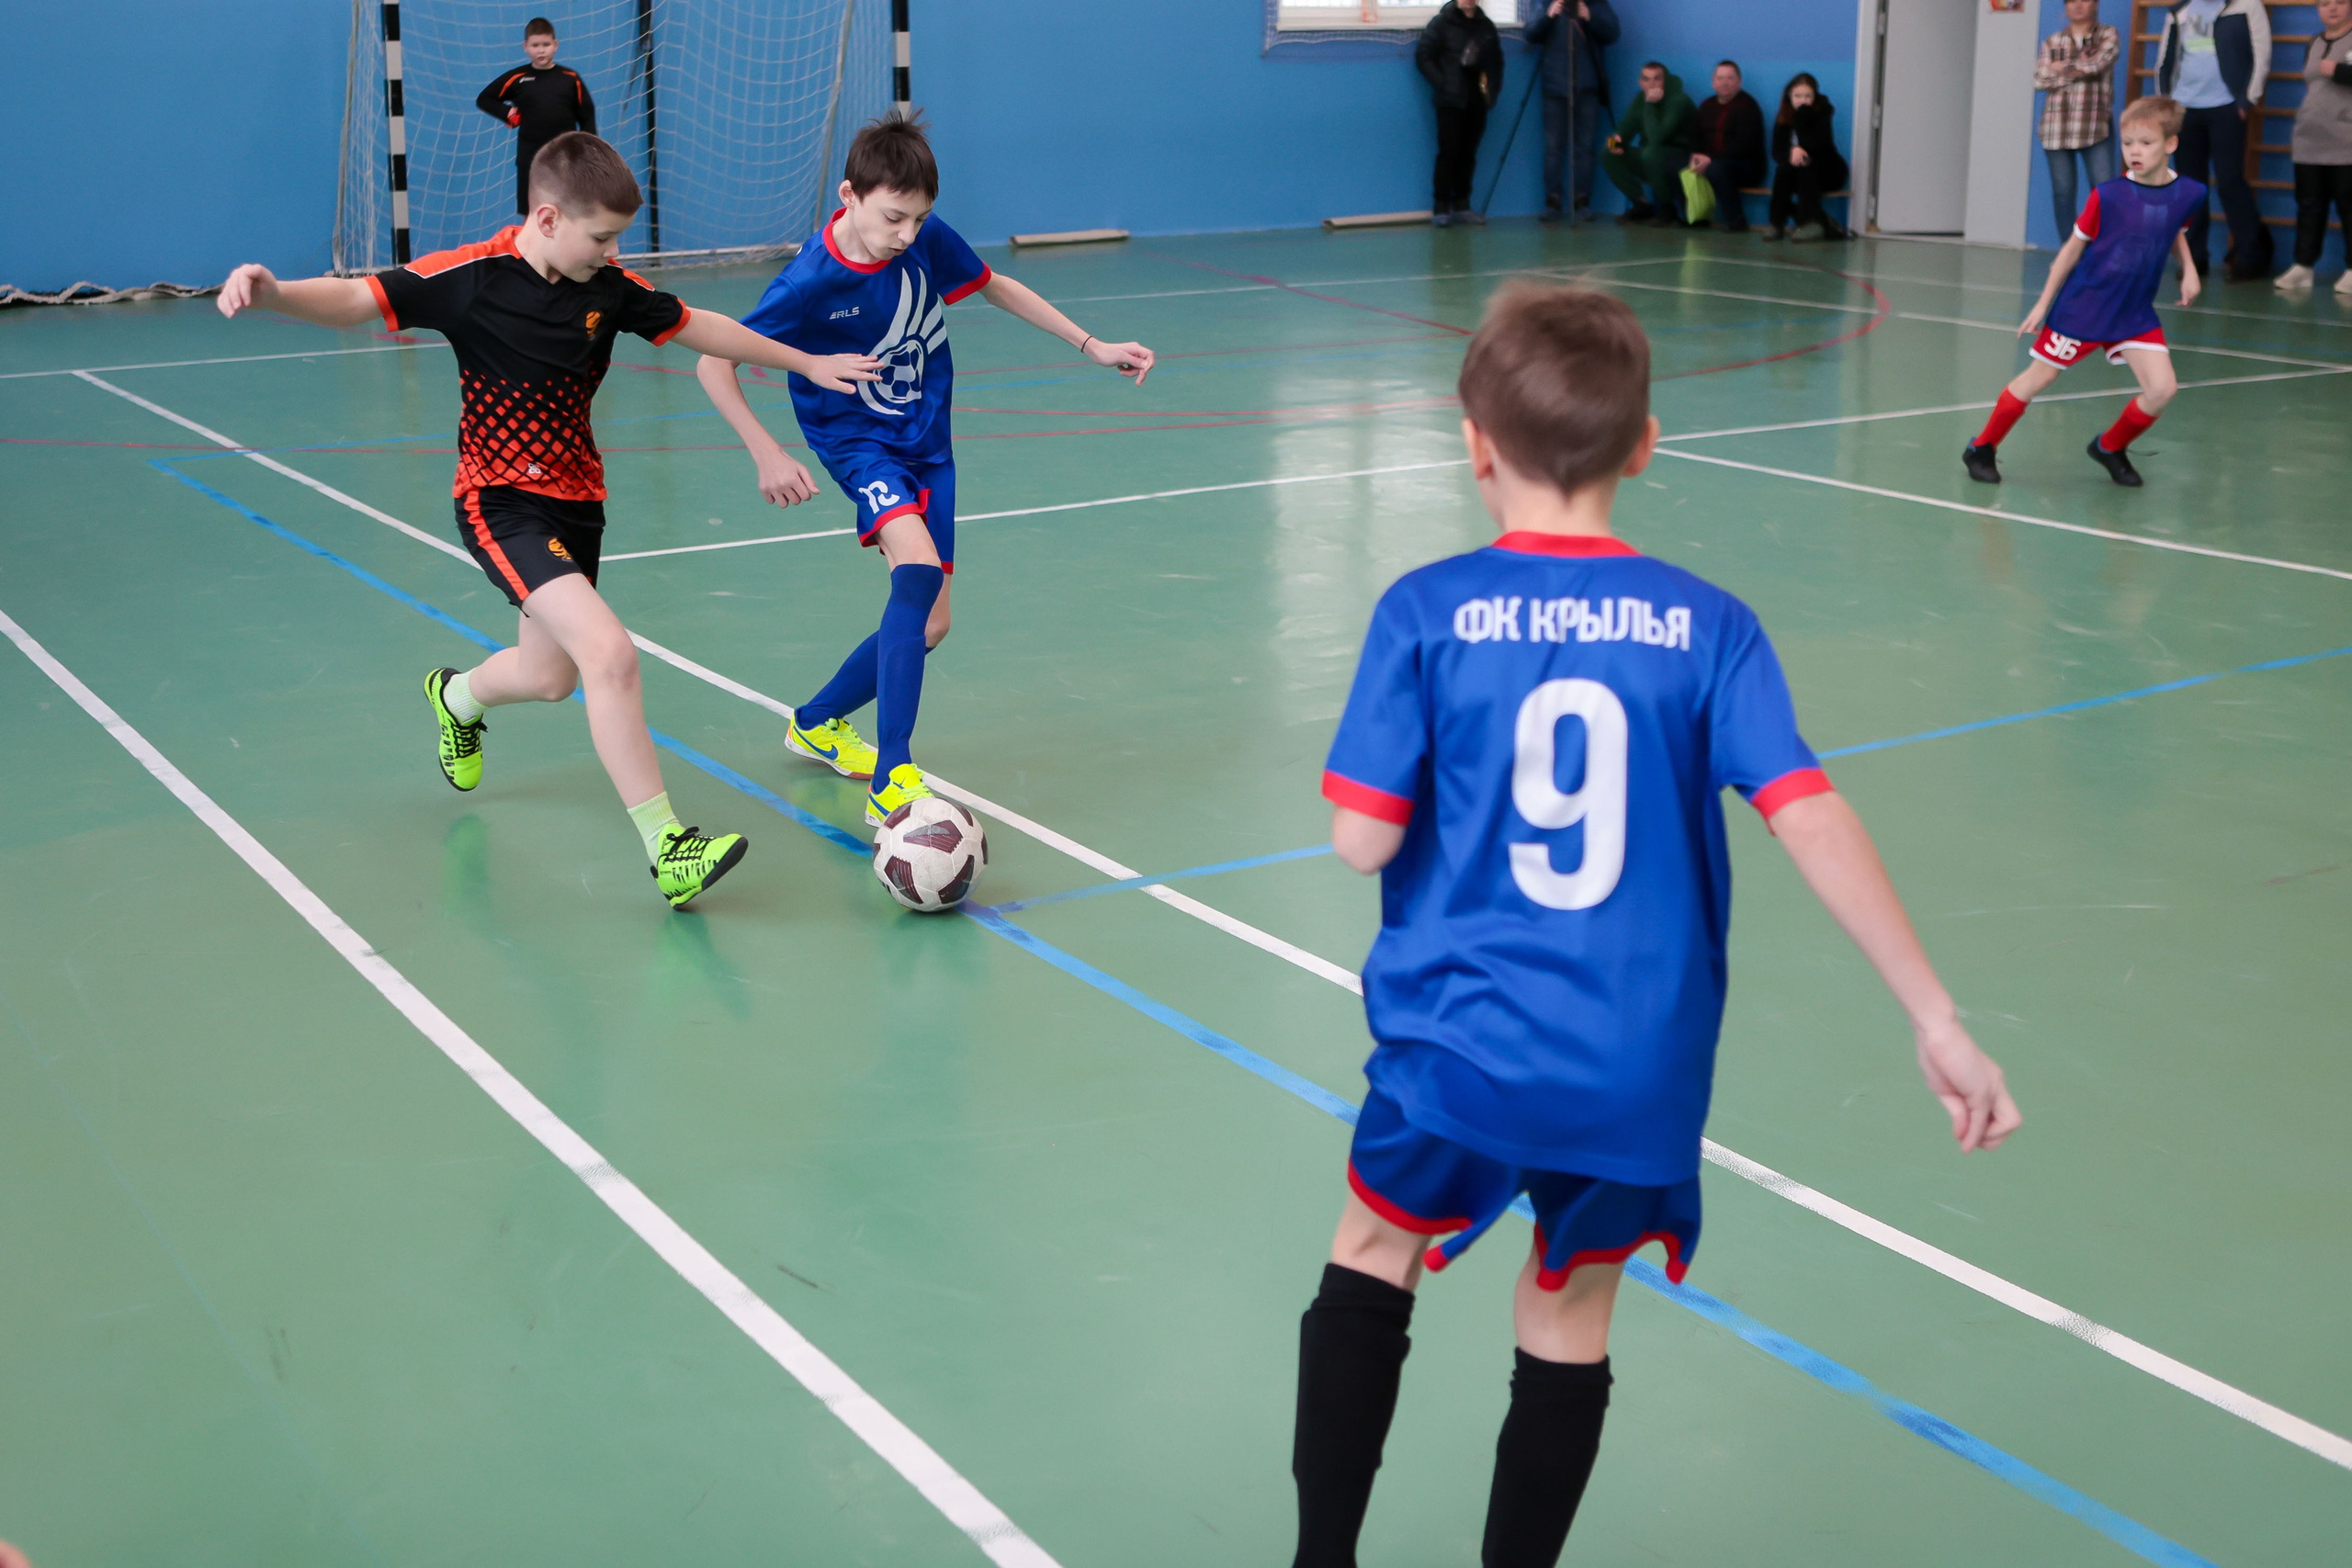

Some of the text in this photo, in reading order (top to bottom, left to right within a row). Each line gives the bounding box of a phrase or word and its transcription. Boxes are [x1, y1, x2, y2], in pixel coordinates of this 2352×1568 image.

[2044, 331, 2082, 361] 96
[1453, 596, 1691, 652] ФК КРЫЛЬЯ
[1509, 678, 1628, 911] 9
